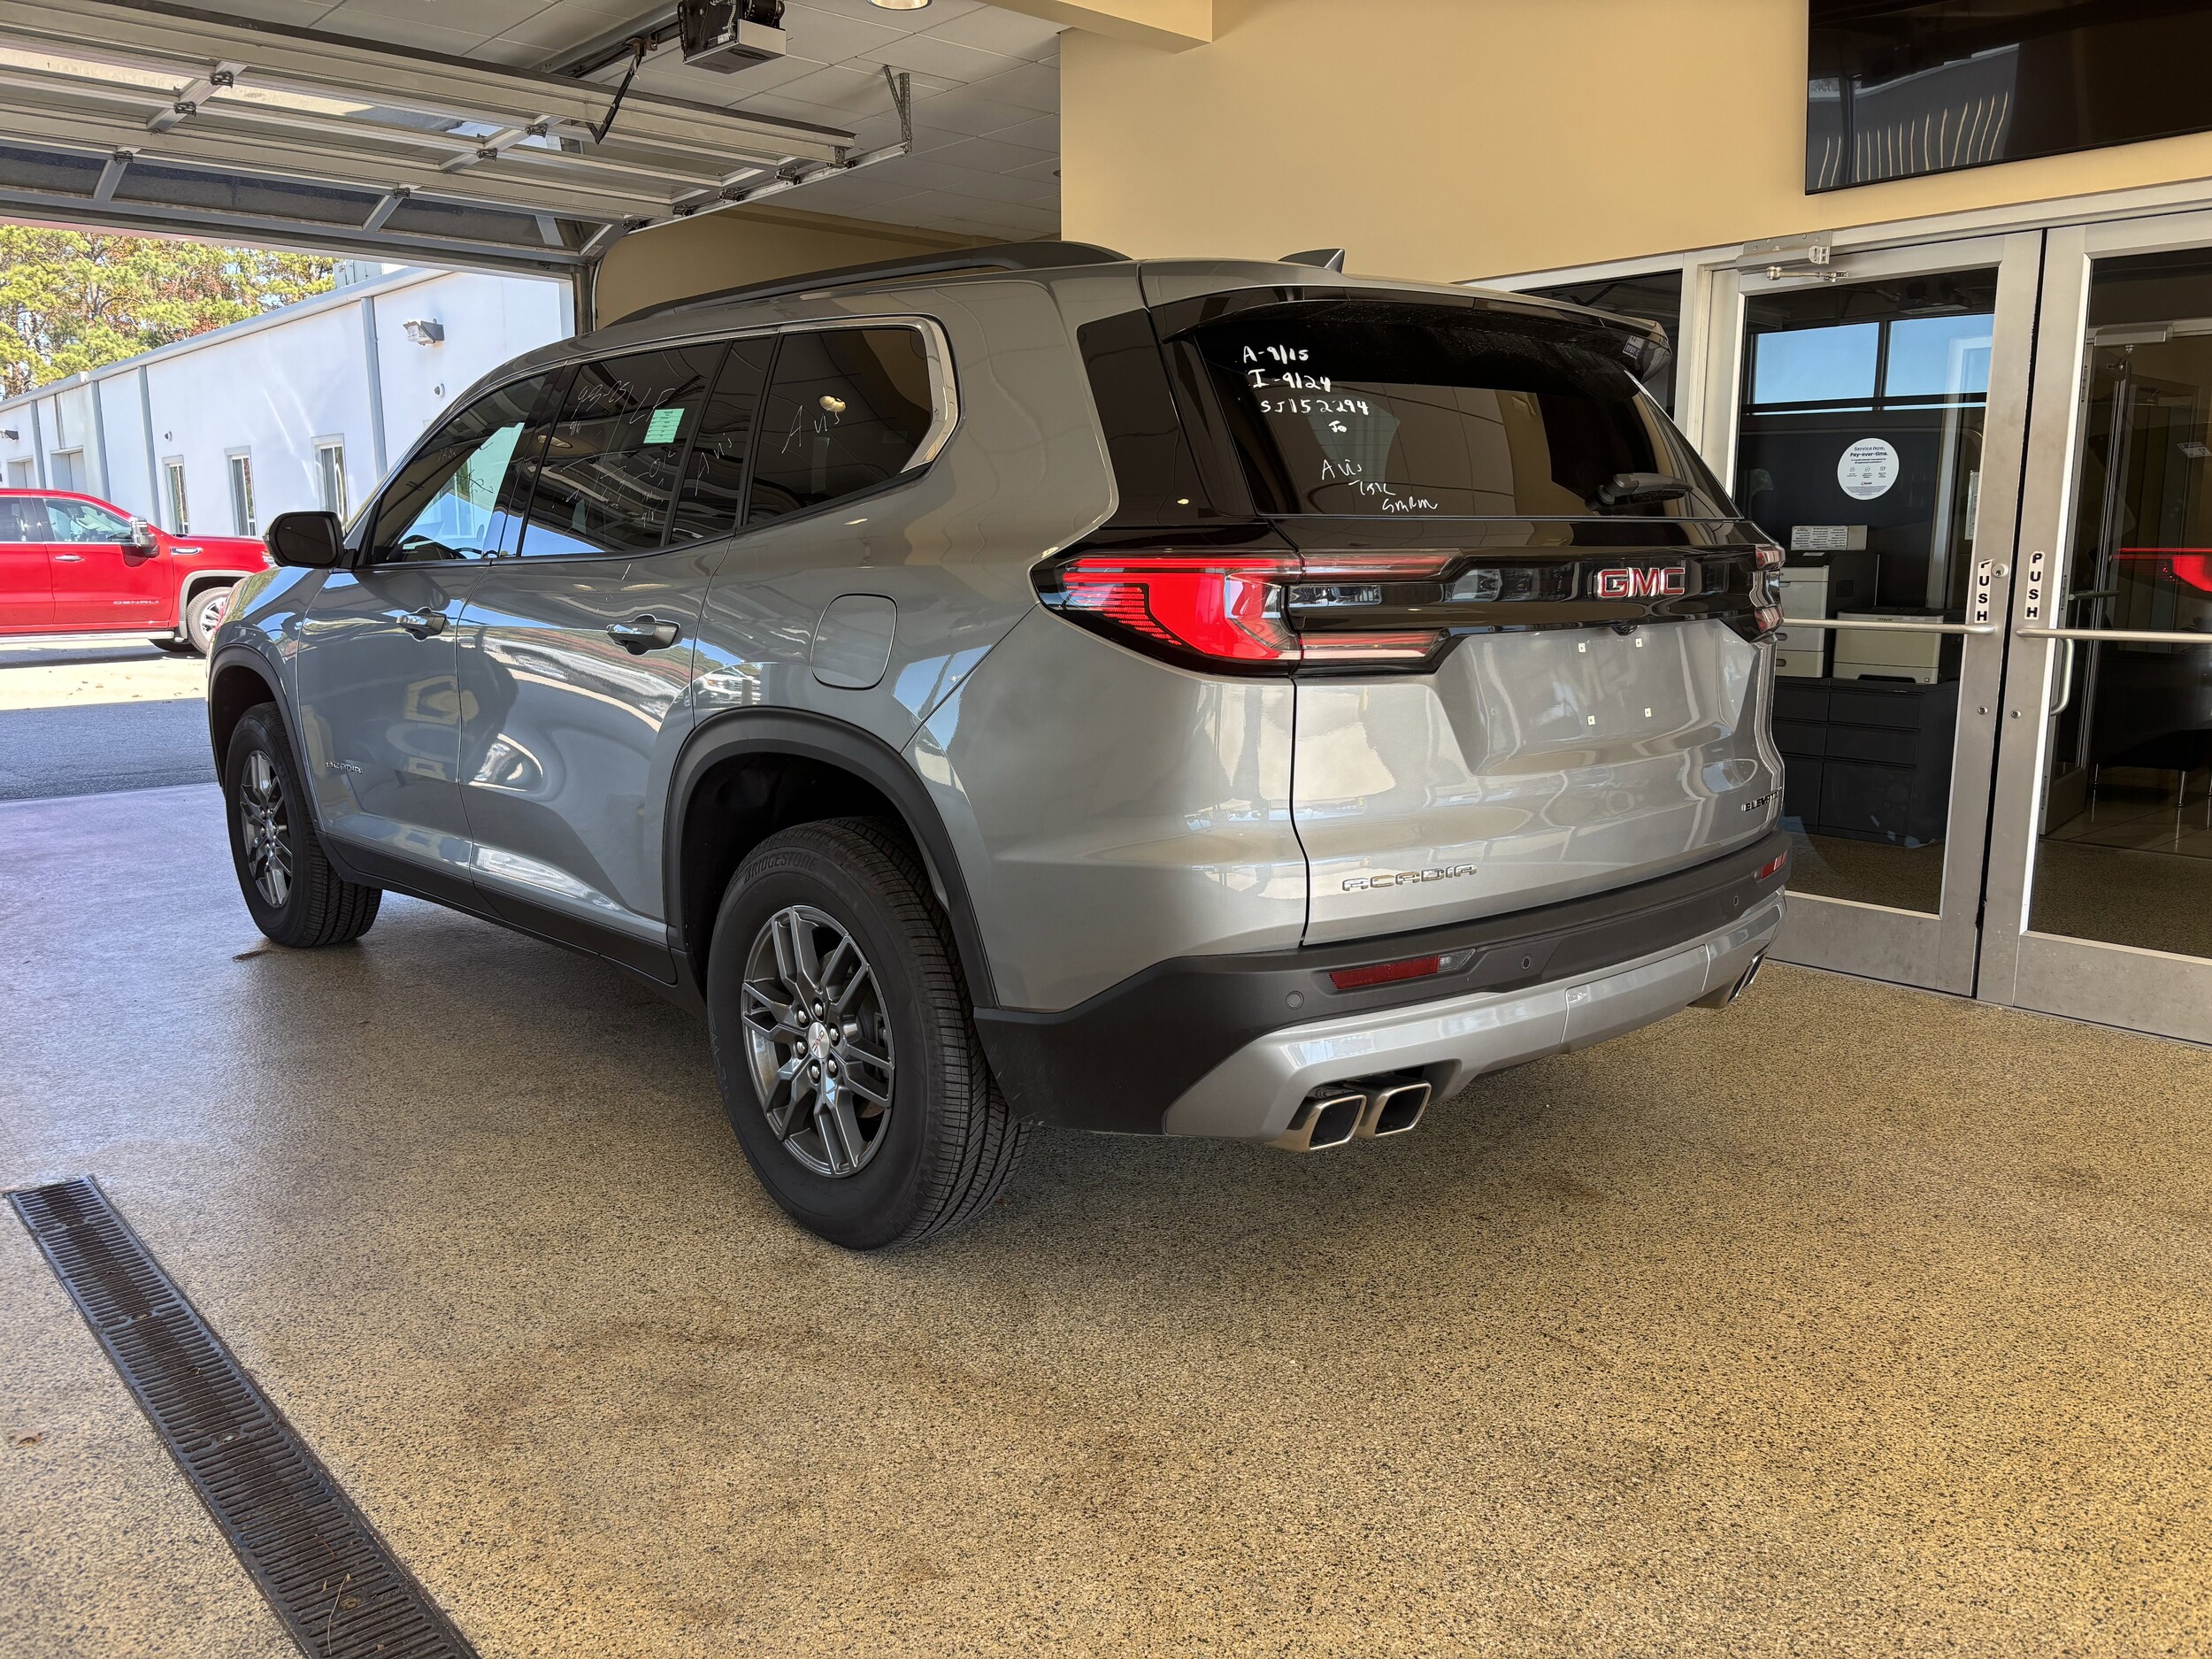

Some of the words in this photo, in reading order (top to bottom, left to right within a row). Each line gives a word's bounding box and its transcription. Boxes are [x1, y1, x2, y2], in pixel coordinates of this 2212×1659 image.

[1260, 398, 1370, 415] SJ152294
[1597, 566, 1686, 598] GMC
[2026, 553, 2043, 618] PUSH
[744, 850, 819, 885] BRIDGESTONE
[1342, 863, 1478, 892] ACADIA
